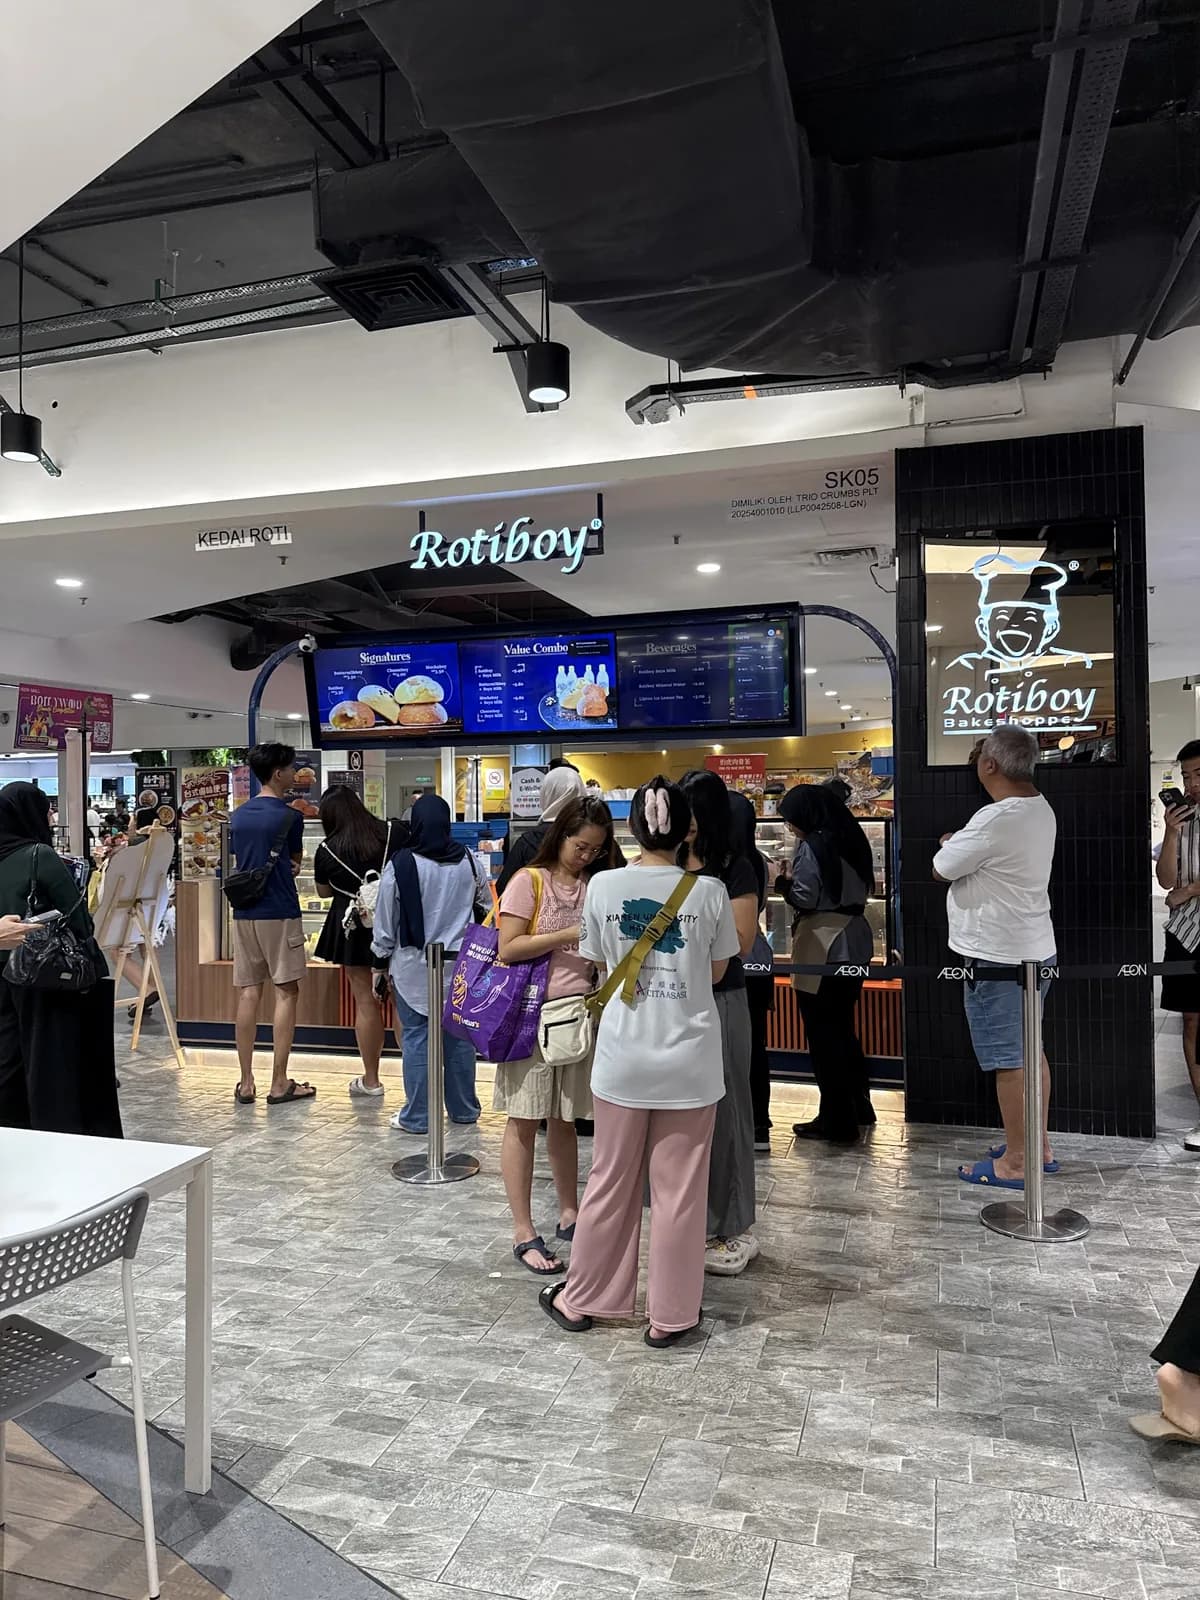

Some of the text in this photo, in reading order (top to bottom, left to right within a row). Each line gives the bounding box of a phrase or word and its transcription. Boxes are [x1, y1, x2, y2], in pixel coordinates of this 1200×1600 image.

[824, 467, 880, 489] SK05
[731, 486, 879, 508] DIMILIKI OLEH TRIO CRUMBS PLT
[731, 506, 785, 518] 20254001010
[198, 525, 288, 547] KEDAI ROTI
[503, 643, 531, 656] Value
[532, 641, 569, 655] Combo
[645, 641, 697, 655] Beverages
[359, 651, 411, 664] Signatures
[942, 678, 1097, 723] Rotiboy
[943, 715, 1071, 729] Bakeshoppe
